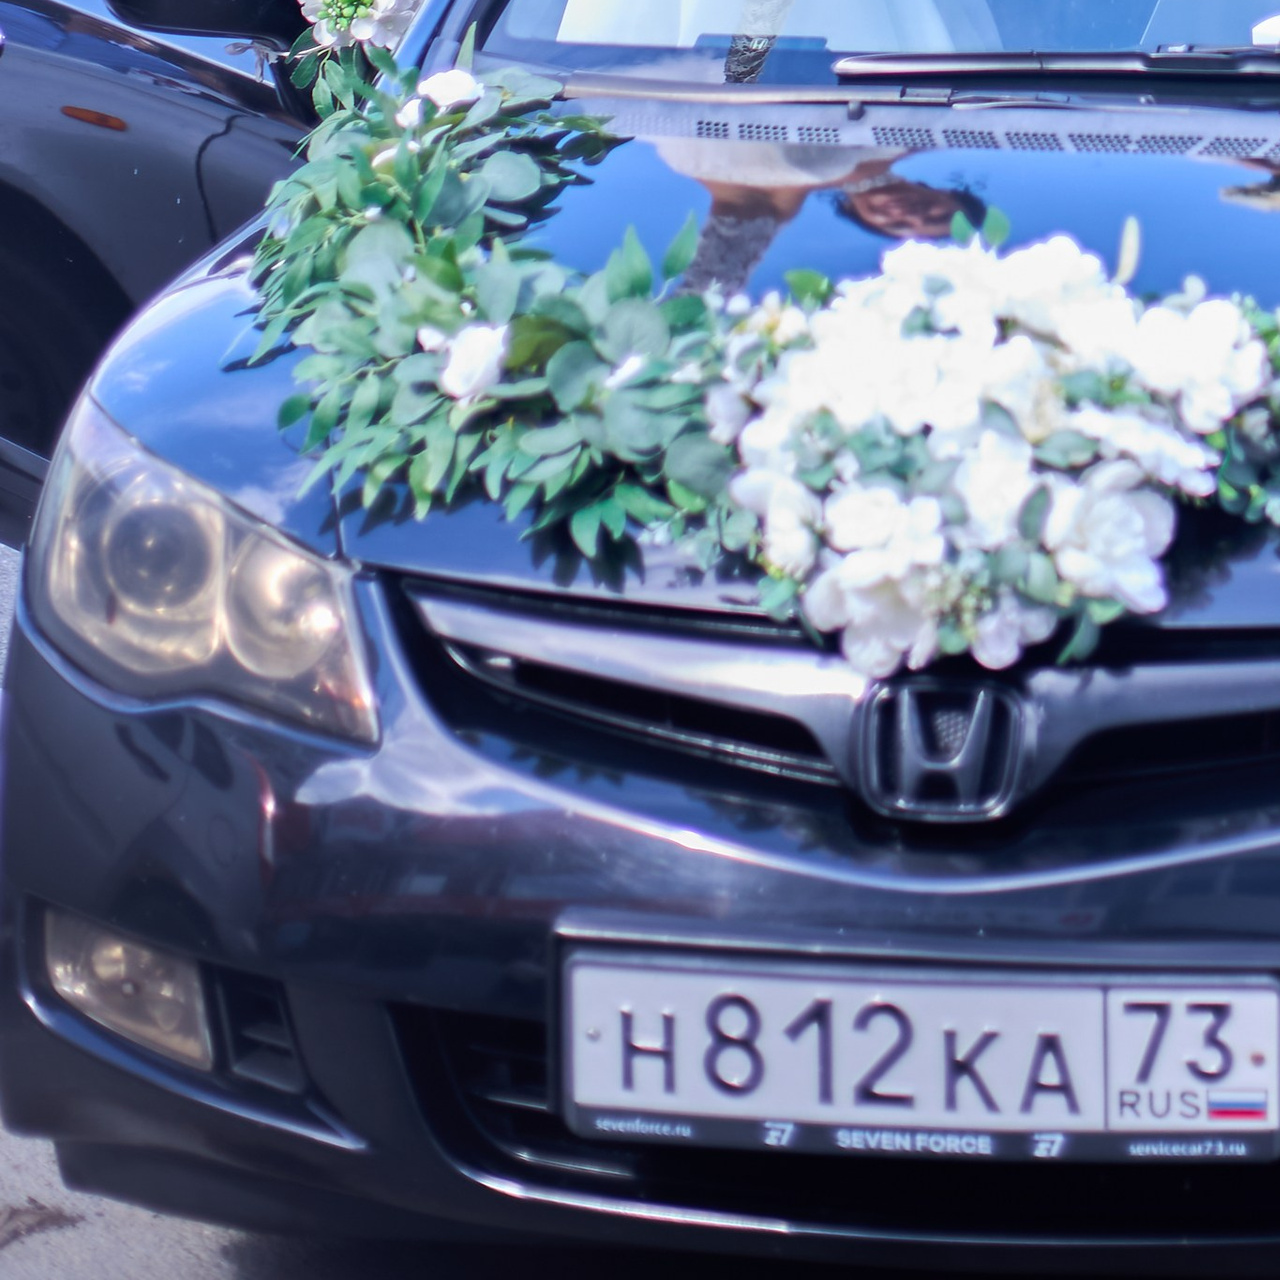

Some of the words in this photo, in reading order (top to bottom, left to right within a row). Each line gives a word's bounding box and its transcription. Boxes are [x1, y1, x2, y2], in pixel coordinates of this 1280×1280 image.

[1123, 1001, 1234, 1084] 73
[1118, 1090, 1201, 1119] RUS
[594, 1117, 692, 1138] sevenforce.ru
[836, 1128, 911, 1152] SEVEN
[915, 1132, 993, 1155] FORCE
[1128, 1140, 1247, 1157] servicecar73.ru
